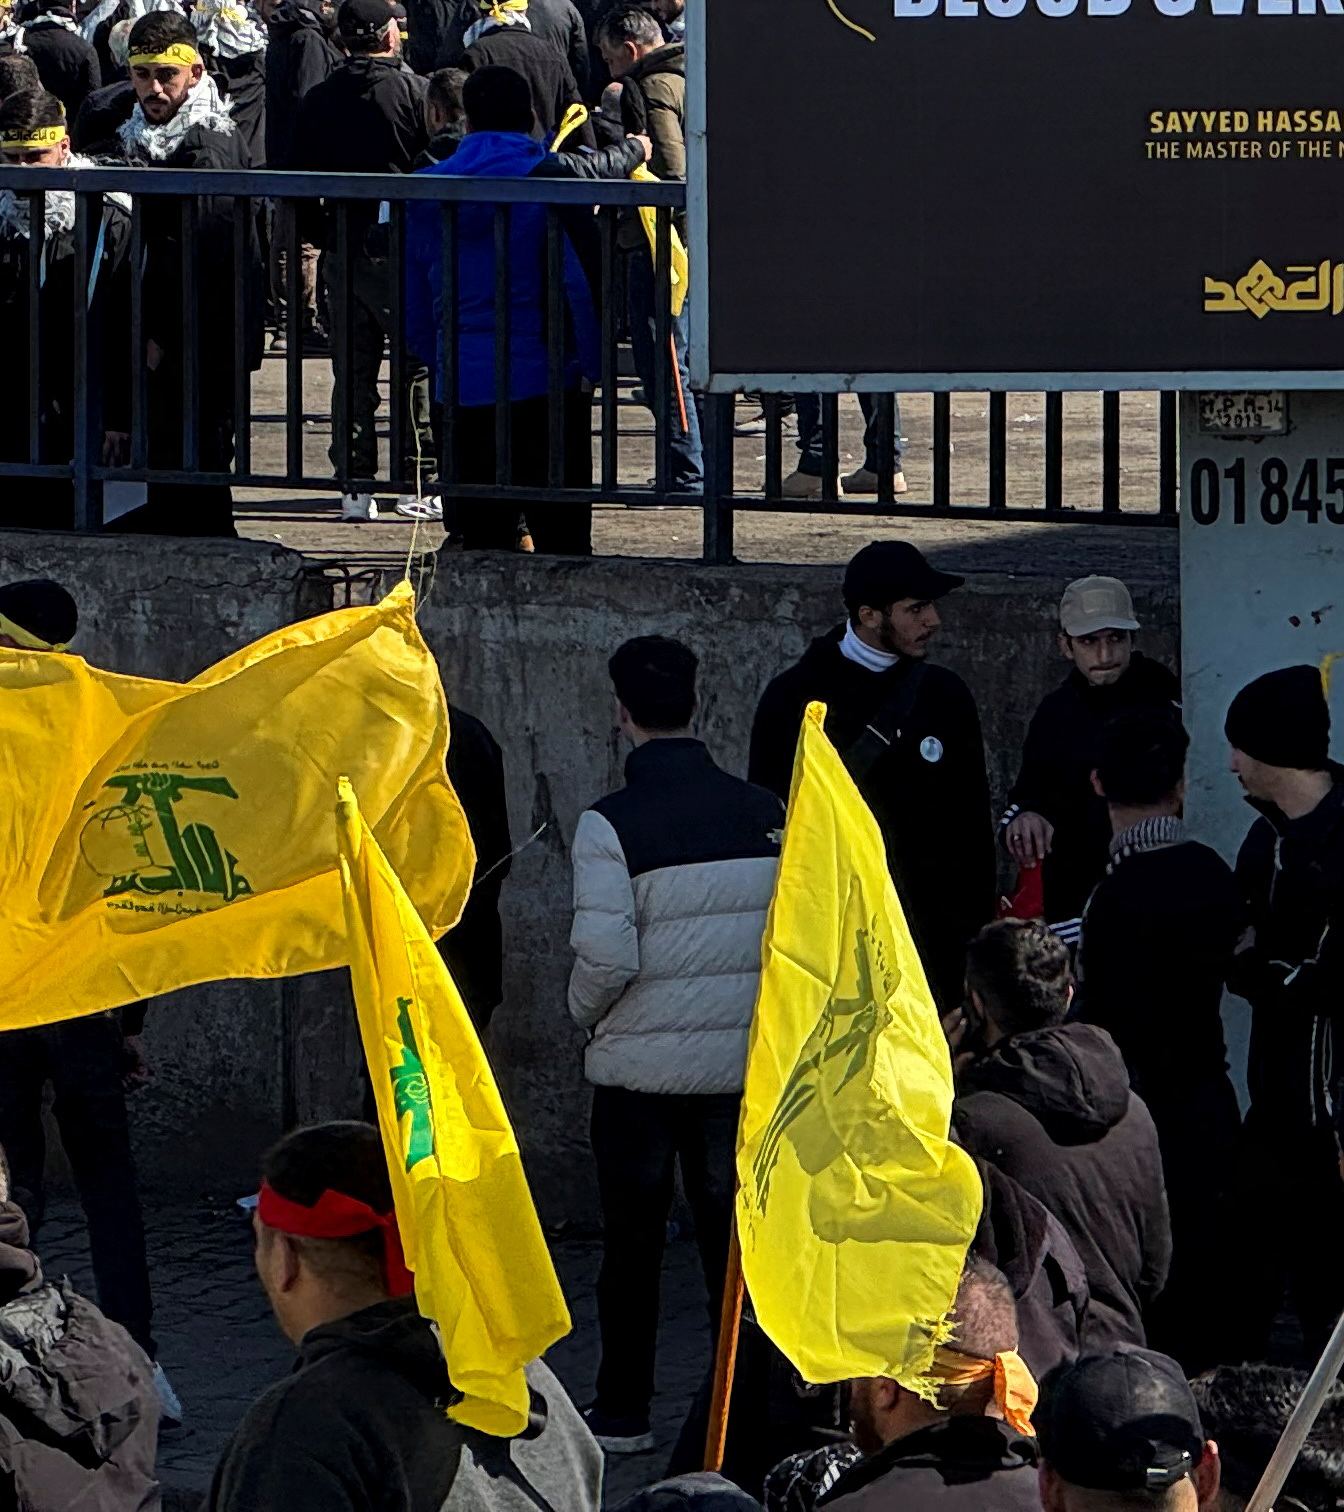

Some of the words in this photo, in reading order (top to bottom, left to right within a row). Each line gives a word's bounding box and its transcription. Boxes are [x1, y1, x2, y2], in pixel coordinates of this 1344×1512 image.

[1151, 111, 1249, 133] SAYYED
[1145, 142, 1180, 158] THE
[1187, 141, 1262, 158] MASTER
[1269, 141, 1291, 158] OF
[1297, 141, 1331, 158] THE
